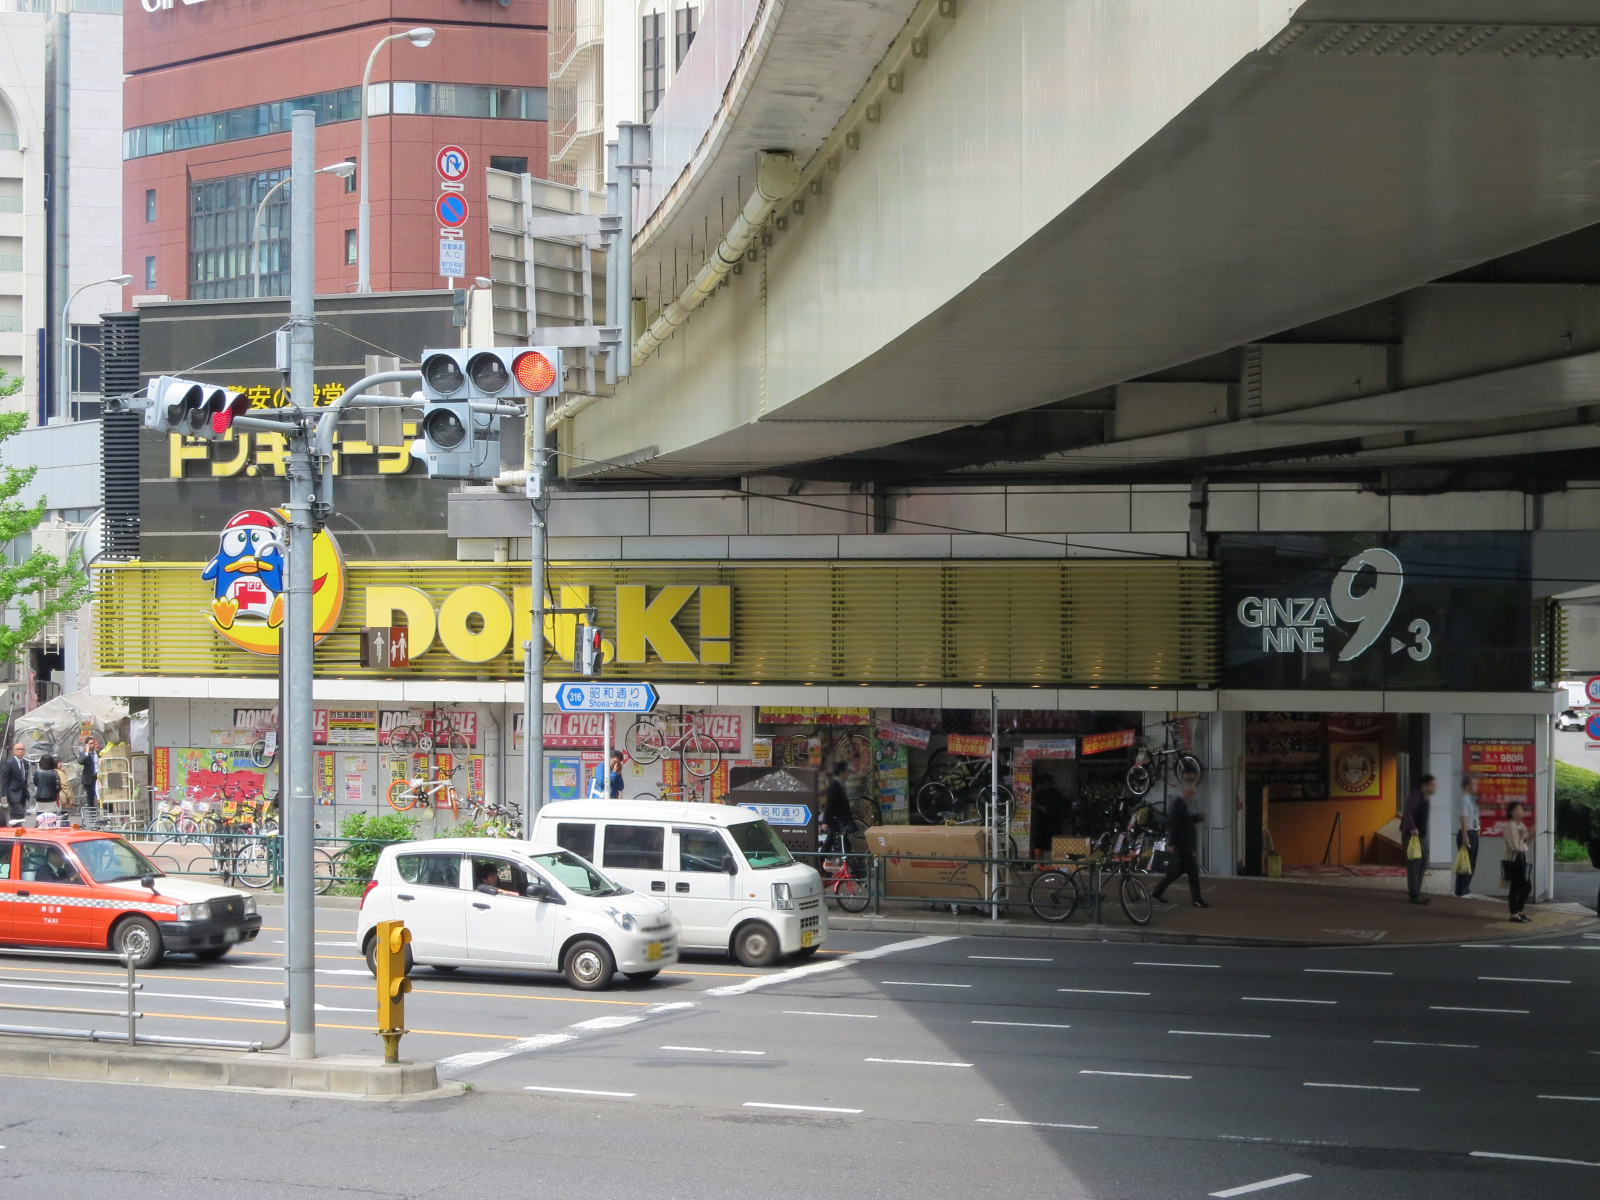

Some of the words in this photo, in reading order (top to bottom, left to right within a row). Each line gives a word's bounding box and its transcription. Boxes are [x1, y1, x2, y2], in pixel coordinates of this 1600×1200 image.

[1331, 548, 1403, 662] 9
[1237, 597, 1336, 627] GINZA
[1262, 627, 1324, 653] NINE
[1407, 618, 1432, 661] 3
[569, 692, 582, 702] 316
[589, 687, 640, 699] 昭和通り
[589, 699, 625, 708] Showa-dori
[1500, 753, 1524, 763] 980円
[761, 806, 800, 817] 昭和通り
